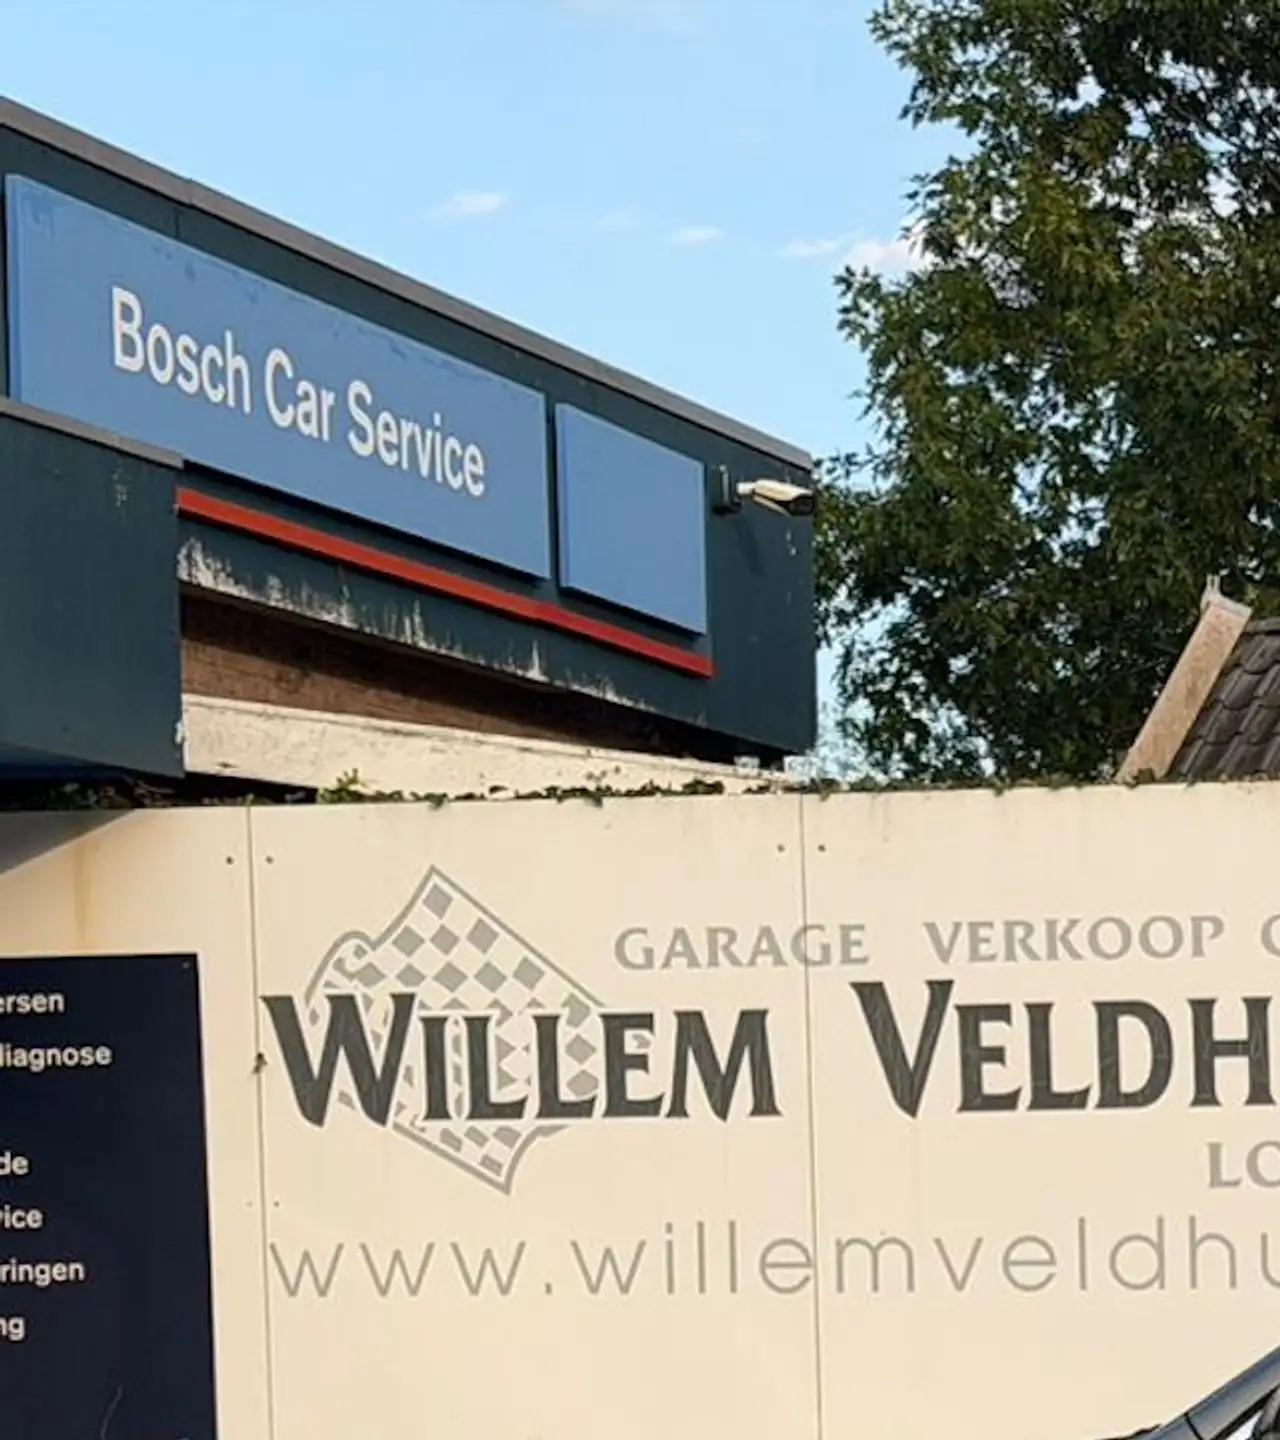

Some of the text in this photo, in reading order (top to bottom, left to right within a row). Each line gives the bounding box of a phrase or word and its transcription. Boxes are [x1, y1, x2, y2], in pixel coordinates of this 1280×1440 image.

[111, 285, 486, 498] Bosch Car Service
[613, 922, 868, 969] GARAGE
[924, 915, 1225, 963] VERKOOP
[0, 1042, 113, 1072] iagnose
[259, 991, 783, 1129] WILLEM
[0, 1204, 43, 1229] ice
